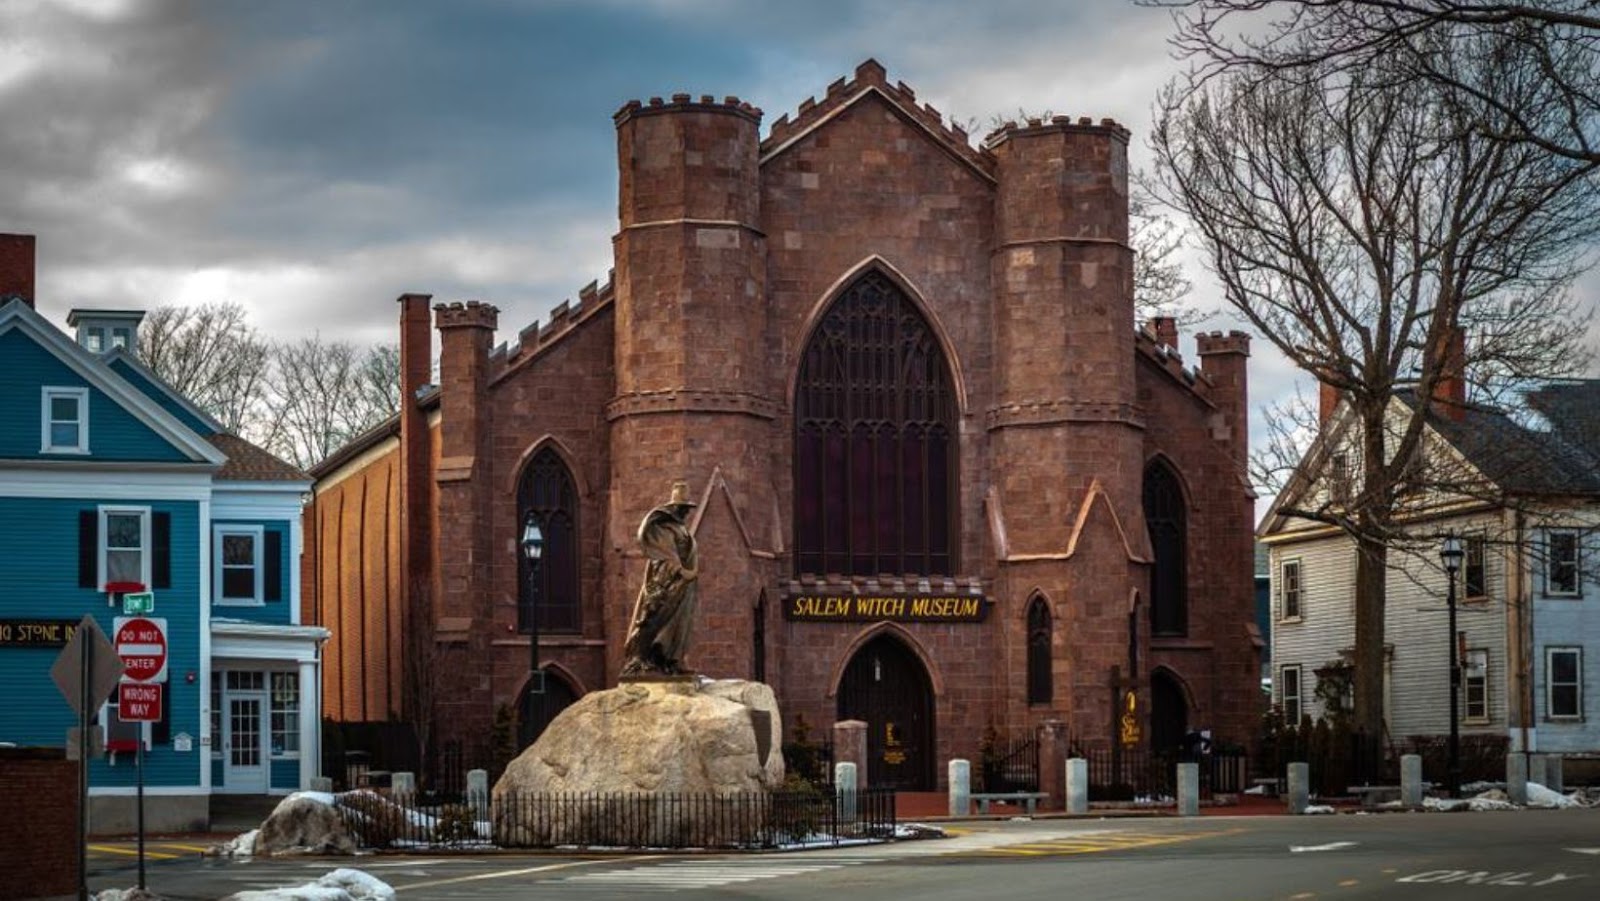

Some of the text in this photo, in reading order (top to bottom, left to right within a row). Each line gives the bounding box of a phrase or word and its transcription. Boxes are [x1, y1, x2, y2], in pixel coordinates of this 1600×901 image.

[793, 598, 979, 617] SALEM WITCH MUSEUM
[18, 624, 61, 641] STONE
[121, 630, 158, 641] DO NOT
[126, 658, 156, 670] ENTER
[124, 687, 158, 702] WRONG
[130, 703, 150, 717] WAY
[1395, 869, 1590, 887] ONLY
